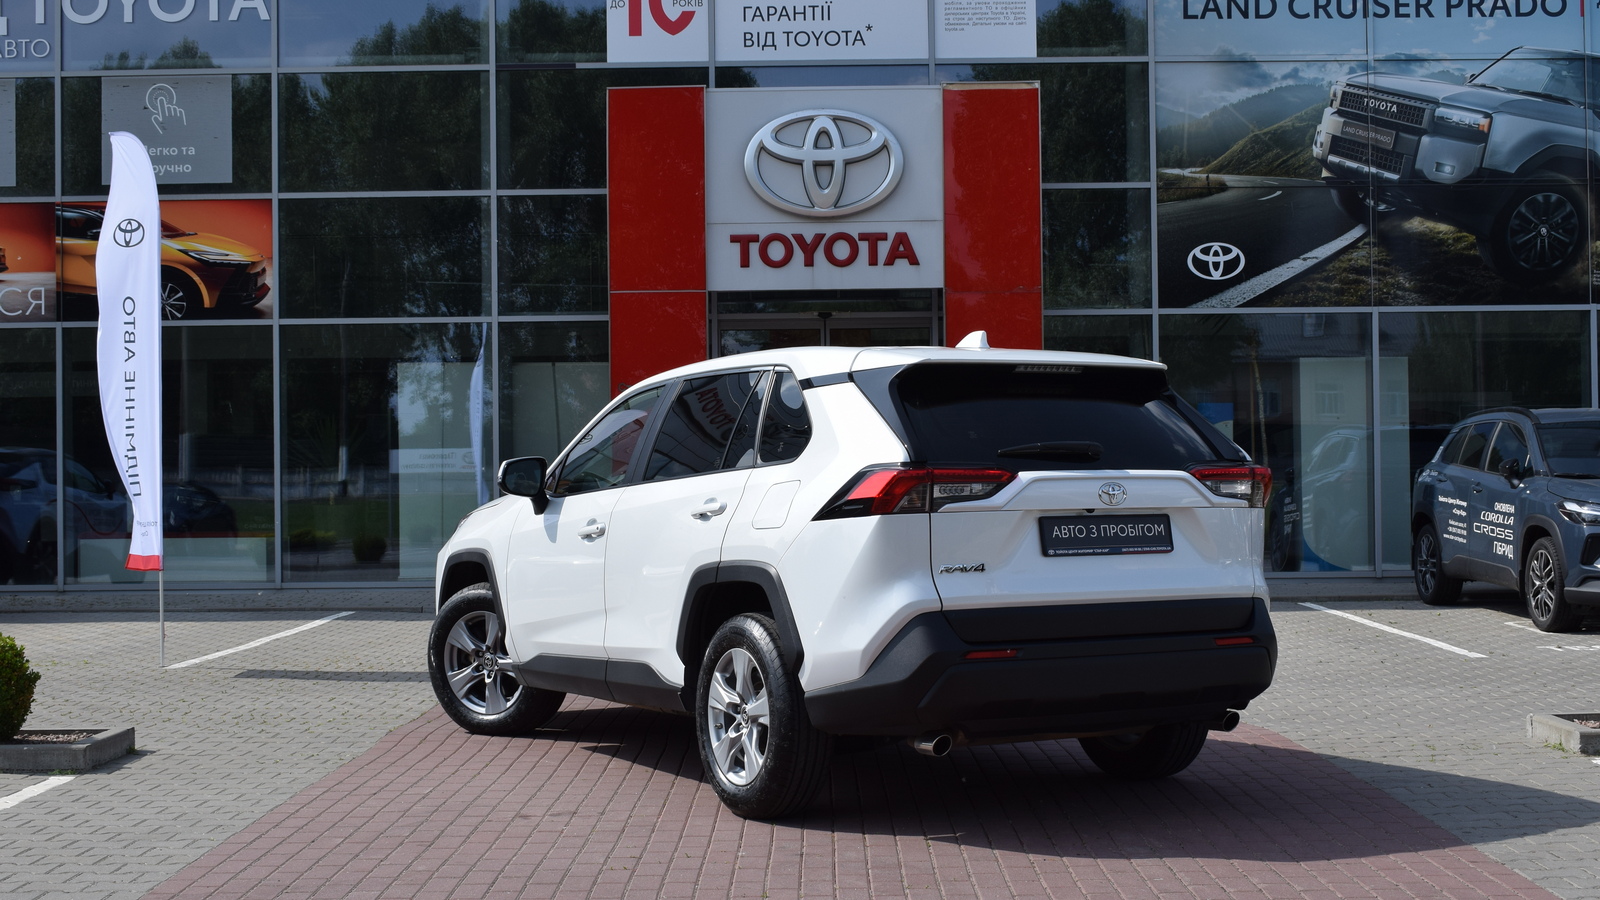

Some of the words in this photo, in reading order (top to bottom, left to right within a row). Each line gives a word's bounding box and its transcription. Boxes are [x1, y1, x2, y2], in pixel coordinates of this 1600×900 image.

[742, 1, 833, 22] ГАРАНТІЇ
[1182, 0, 1278, 19] LAND
[1288, 0, 1435, 19] CRUISER
[1446, 0, 1568, 18] PRADO
[0, 38, 50, 58] ВТО
[743, 31, 777, 51] ВІД
[1363, 98, 1398, 113] TOYOTA
[1343, 125, 1356, 134] LAND
[1355, 128, 1376, 139] CRUISER
[1375, 133, 1392, 143] PRADO
[181, 146, 196, 155] та
[730, 231, 920, 269] TOYOTA
[1494, 501, 1515, 514] ОНОВЛЕНА
[1480, 510, 1514, 526] COROLLA
[1052, 525, 1086, 538] АВТО
[1100, 523, 1165, 538] ПРОБІГОМ
[1473, 522, 1514, 540] CROSS
[938, 562, 986, 575] RAV4
